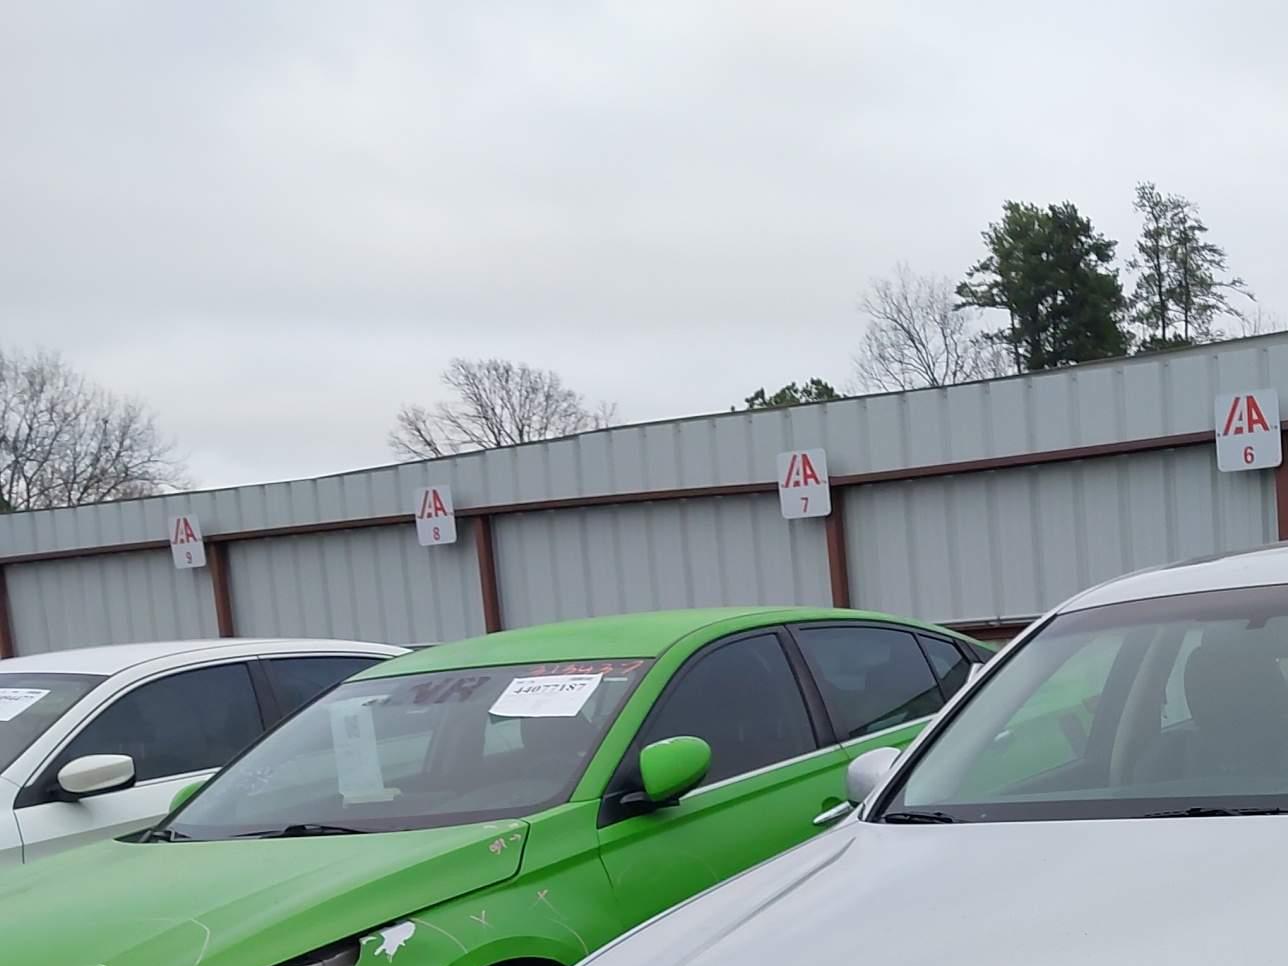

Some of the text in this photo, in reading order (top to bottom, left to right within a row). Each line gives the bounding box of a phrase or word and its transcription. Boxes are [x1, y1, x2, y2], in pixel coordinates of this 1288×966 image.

[1243, 446, 1255, 465] 6
[800, 496, 809, 513] 7
[432, 526, 441, 541] 8
